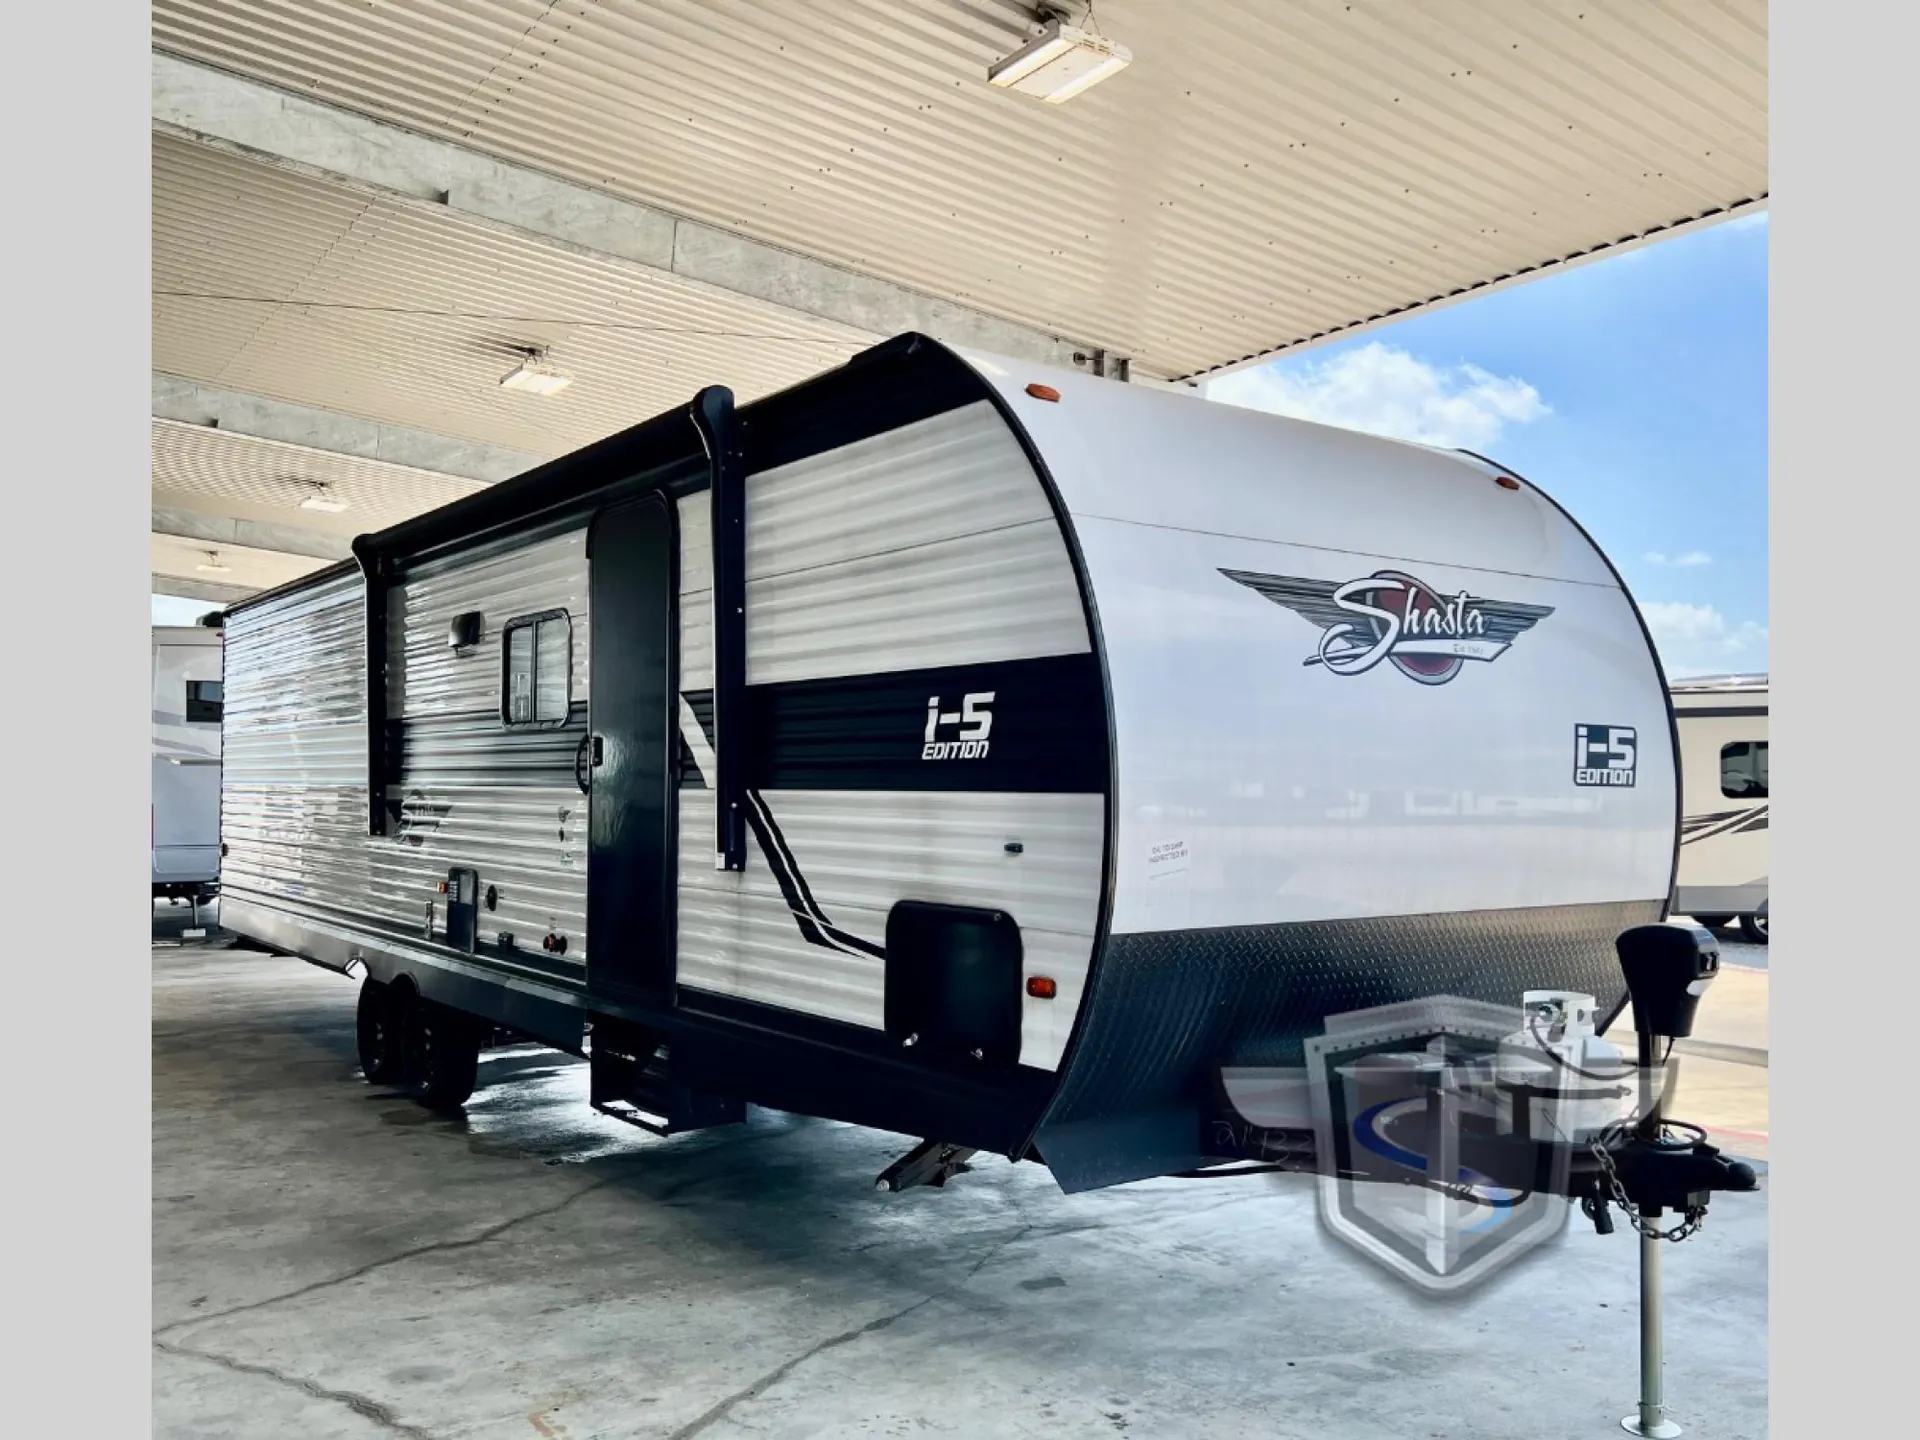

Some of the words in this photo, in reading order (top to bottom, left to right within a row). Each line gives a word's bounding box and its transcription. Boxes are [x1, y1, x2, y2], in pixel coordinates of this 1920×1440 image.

[1317, 577, 1486, 676] Shasta
[925, 691, 996, 742] i-5
[921, 740, 990, 760] EDITION
[1577, 726, 1635, 768] i-5
[1577, 768, 1634, 785] EDITION
